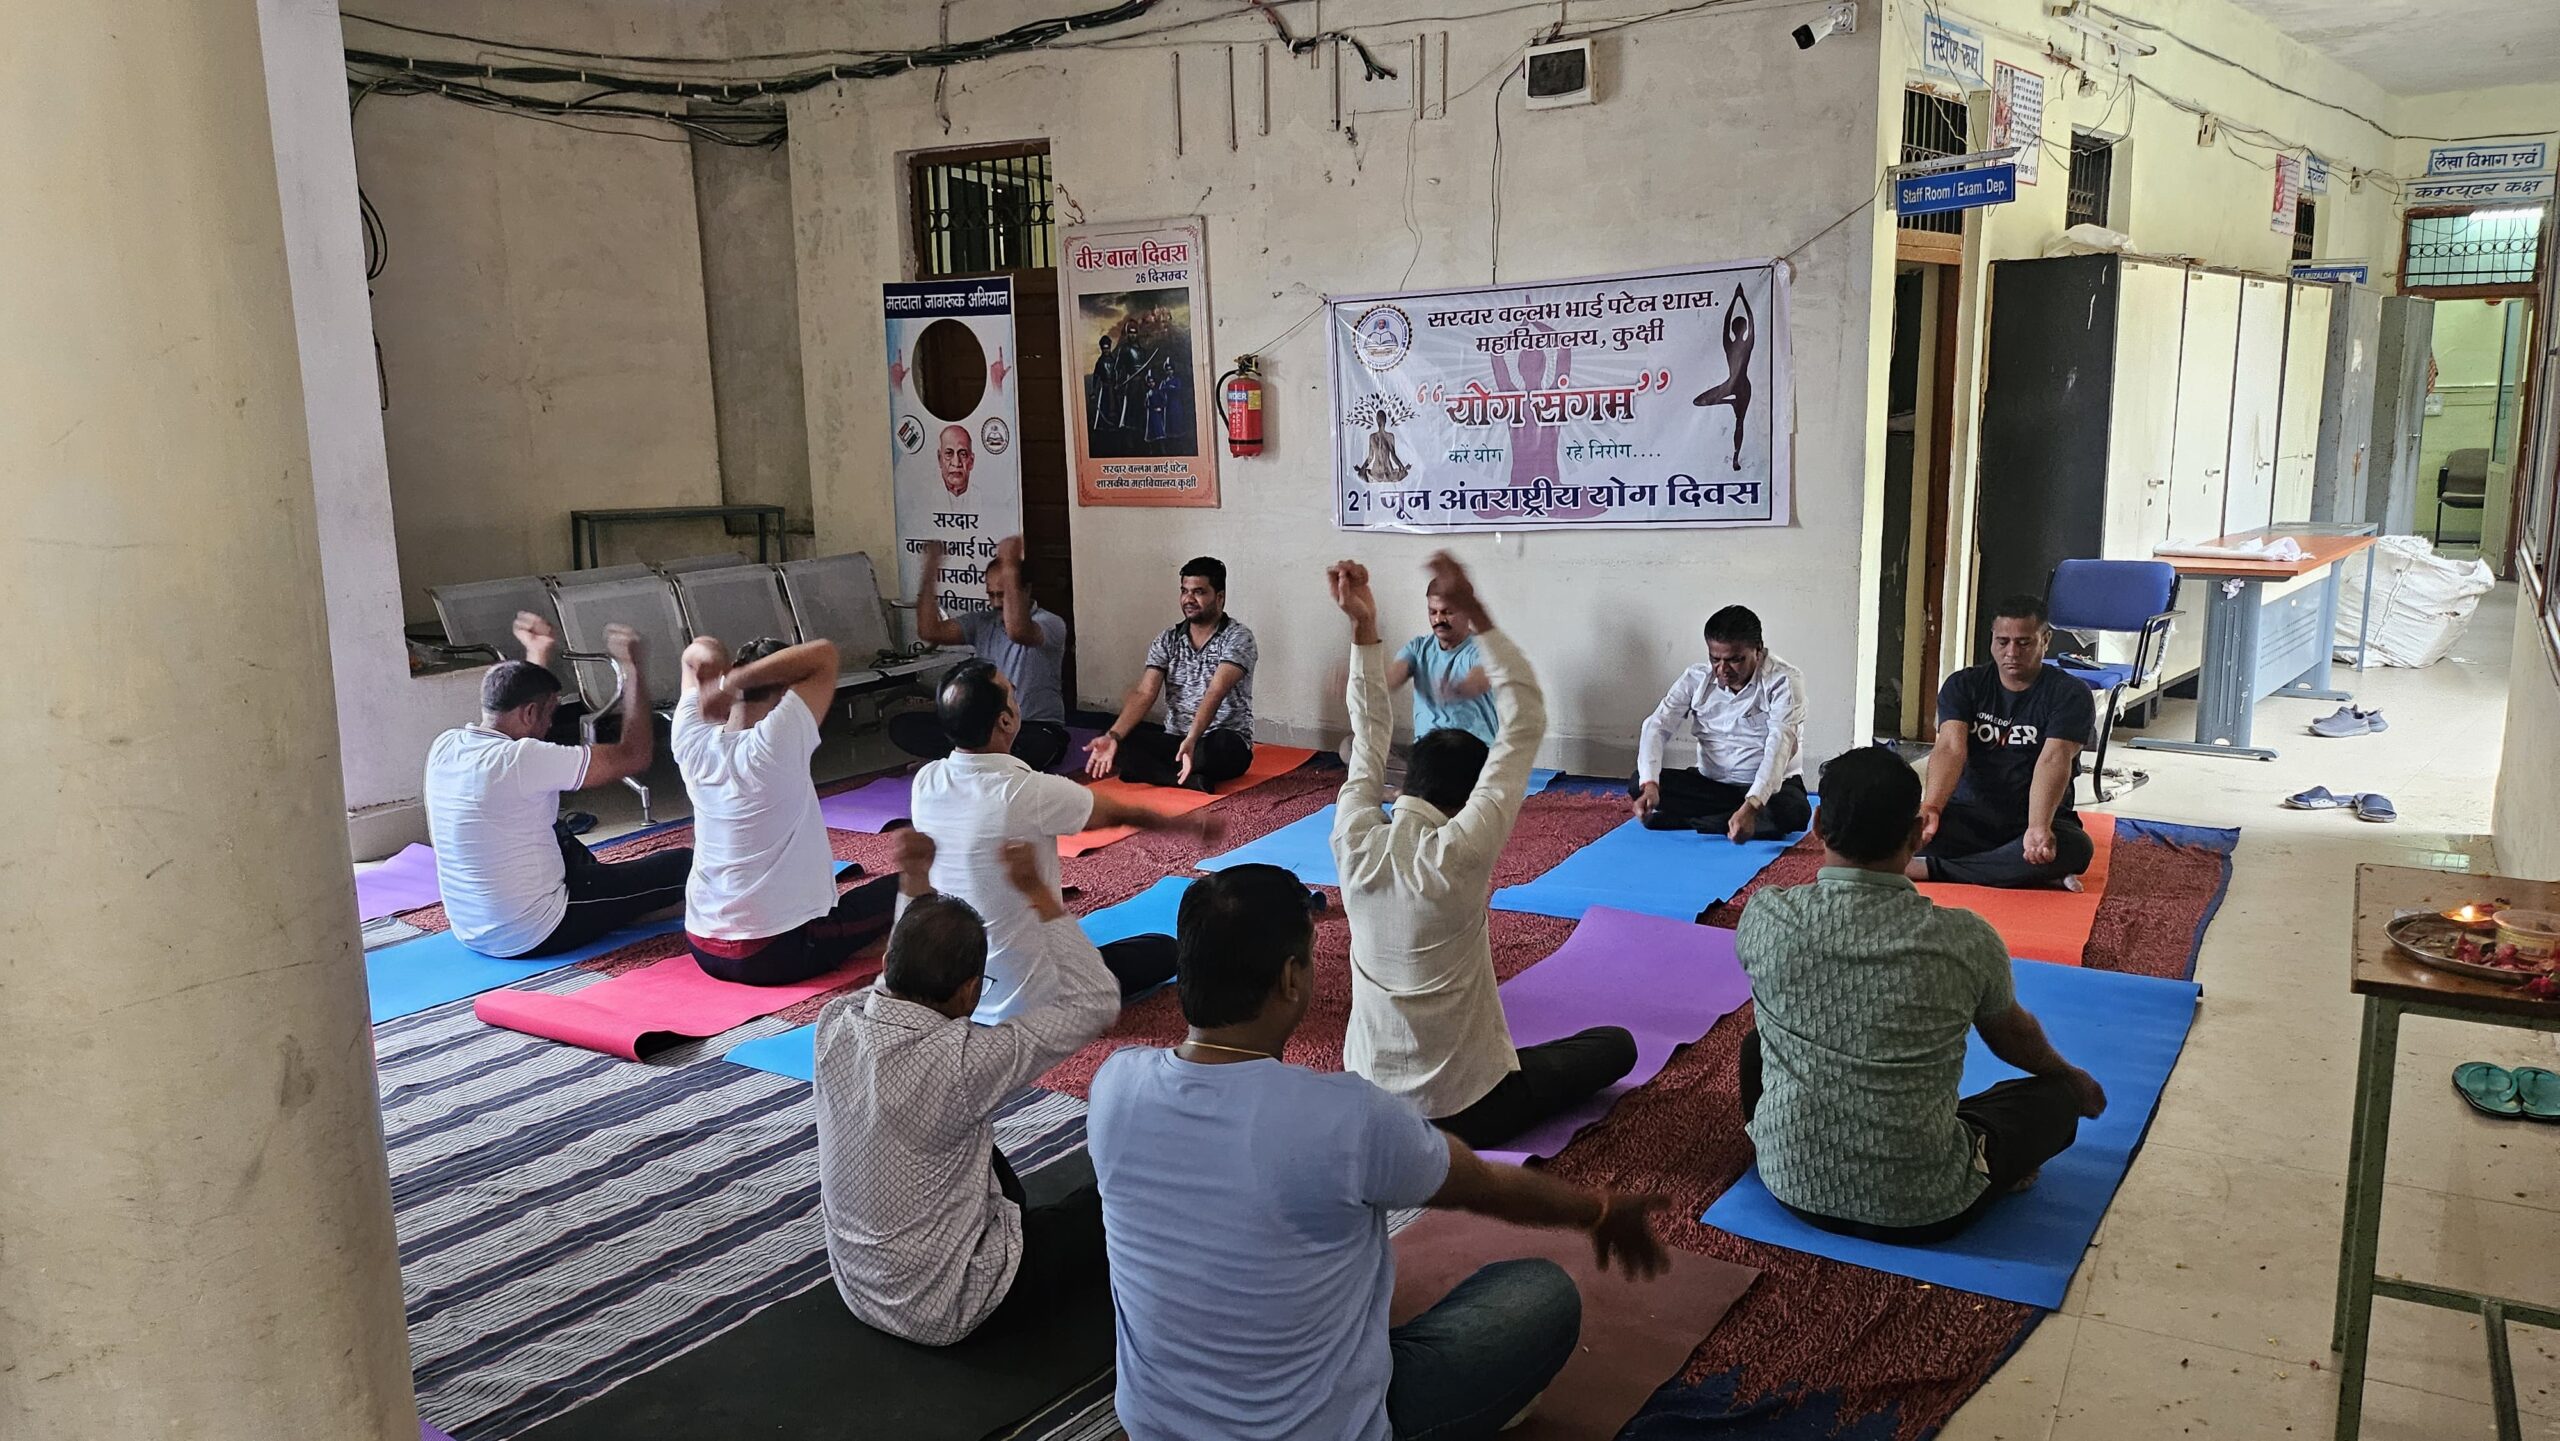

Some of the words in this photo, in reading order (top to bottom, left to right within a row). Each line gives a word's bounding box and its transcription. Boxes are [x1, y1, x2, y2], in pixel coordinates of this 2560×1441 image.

[2434, 153, 2463, 170] लेखा
[2466, 152, 2508, 168] विभाग
[2511, 148, 2538, 167] एवं
[1903, 187, 1923, 203] Staff
[1925, 187, 1950, 201] Room
[1957, 182, 1985, 197] Exam.
[1986, 178, 2007, 195] Dep.
[2504, 181, 2543, 196] कक्ष
[1075, 245, 1104, 269] वीर
[1106, 249, 1138, 267] बाल
[1142, 240, 1188, 265] दिवस
[1136, 272, 1146, 284] 26
[1148, 269, 1188, 283] दिसम्बर
[885, 295, 922, 310] मतदाता
[968, 286, 1008, 308] अभियान
[1427, 308, 1494, 327] सरदार
[1498, 303, 1561, 322] वल्लभ
[1566, 292, 1605, 318] भाई
[1608, 291, 1658, 314] पटेल
[1662, 291, 1719, 310] शास.
[1475, 327, 1607, 354] महाविद्यालय,
[1612, 318, 1665, 351] कुक्षी
[1448, 443, 1470, 464] करें
[1474, 443, 1504, 463] योग
[1566, 439, 1584, 461] रहे
[1102, 465, 1127, 473] सरदार
[1128, 464, 1152, 473] वल्लभ
[1154, 462, 1169, 473] भाई
[1170, 462, 1188, 473] पटेल
[1096, 477, 1129, 488] शासकीय
[1131, 476, 1176, 488] महाविद्यालय
[1177, 475, 1197, 490] कुक्षी
[1348, 491, 1371, 511] 21
[1380, 491, 1432, 520] जून
[1439, 477, 1582, 516] अंतराष्ट्रीय
[1589, 476, 1659, 507] योग
[1666, 474, 1761, 507] दिवस
[933, 512, 979, 530] सरदार
[978, 537, 999, 558] पटे
